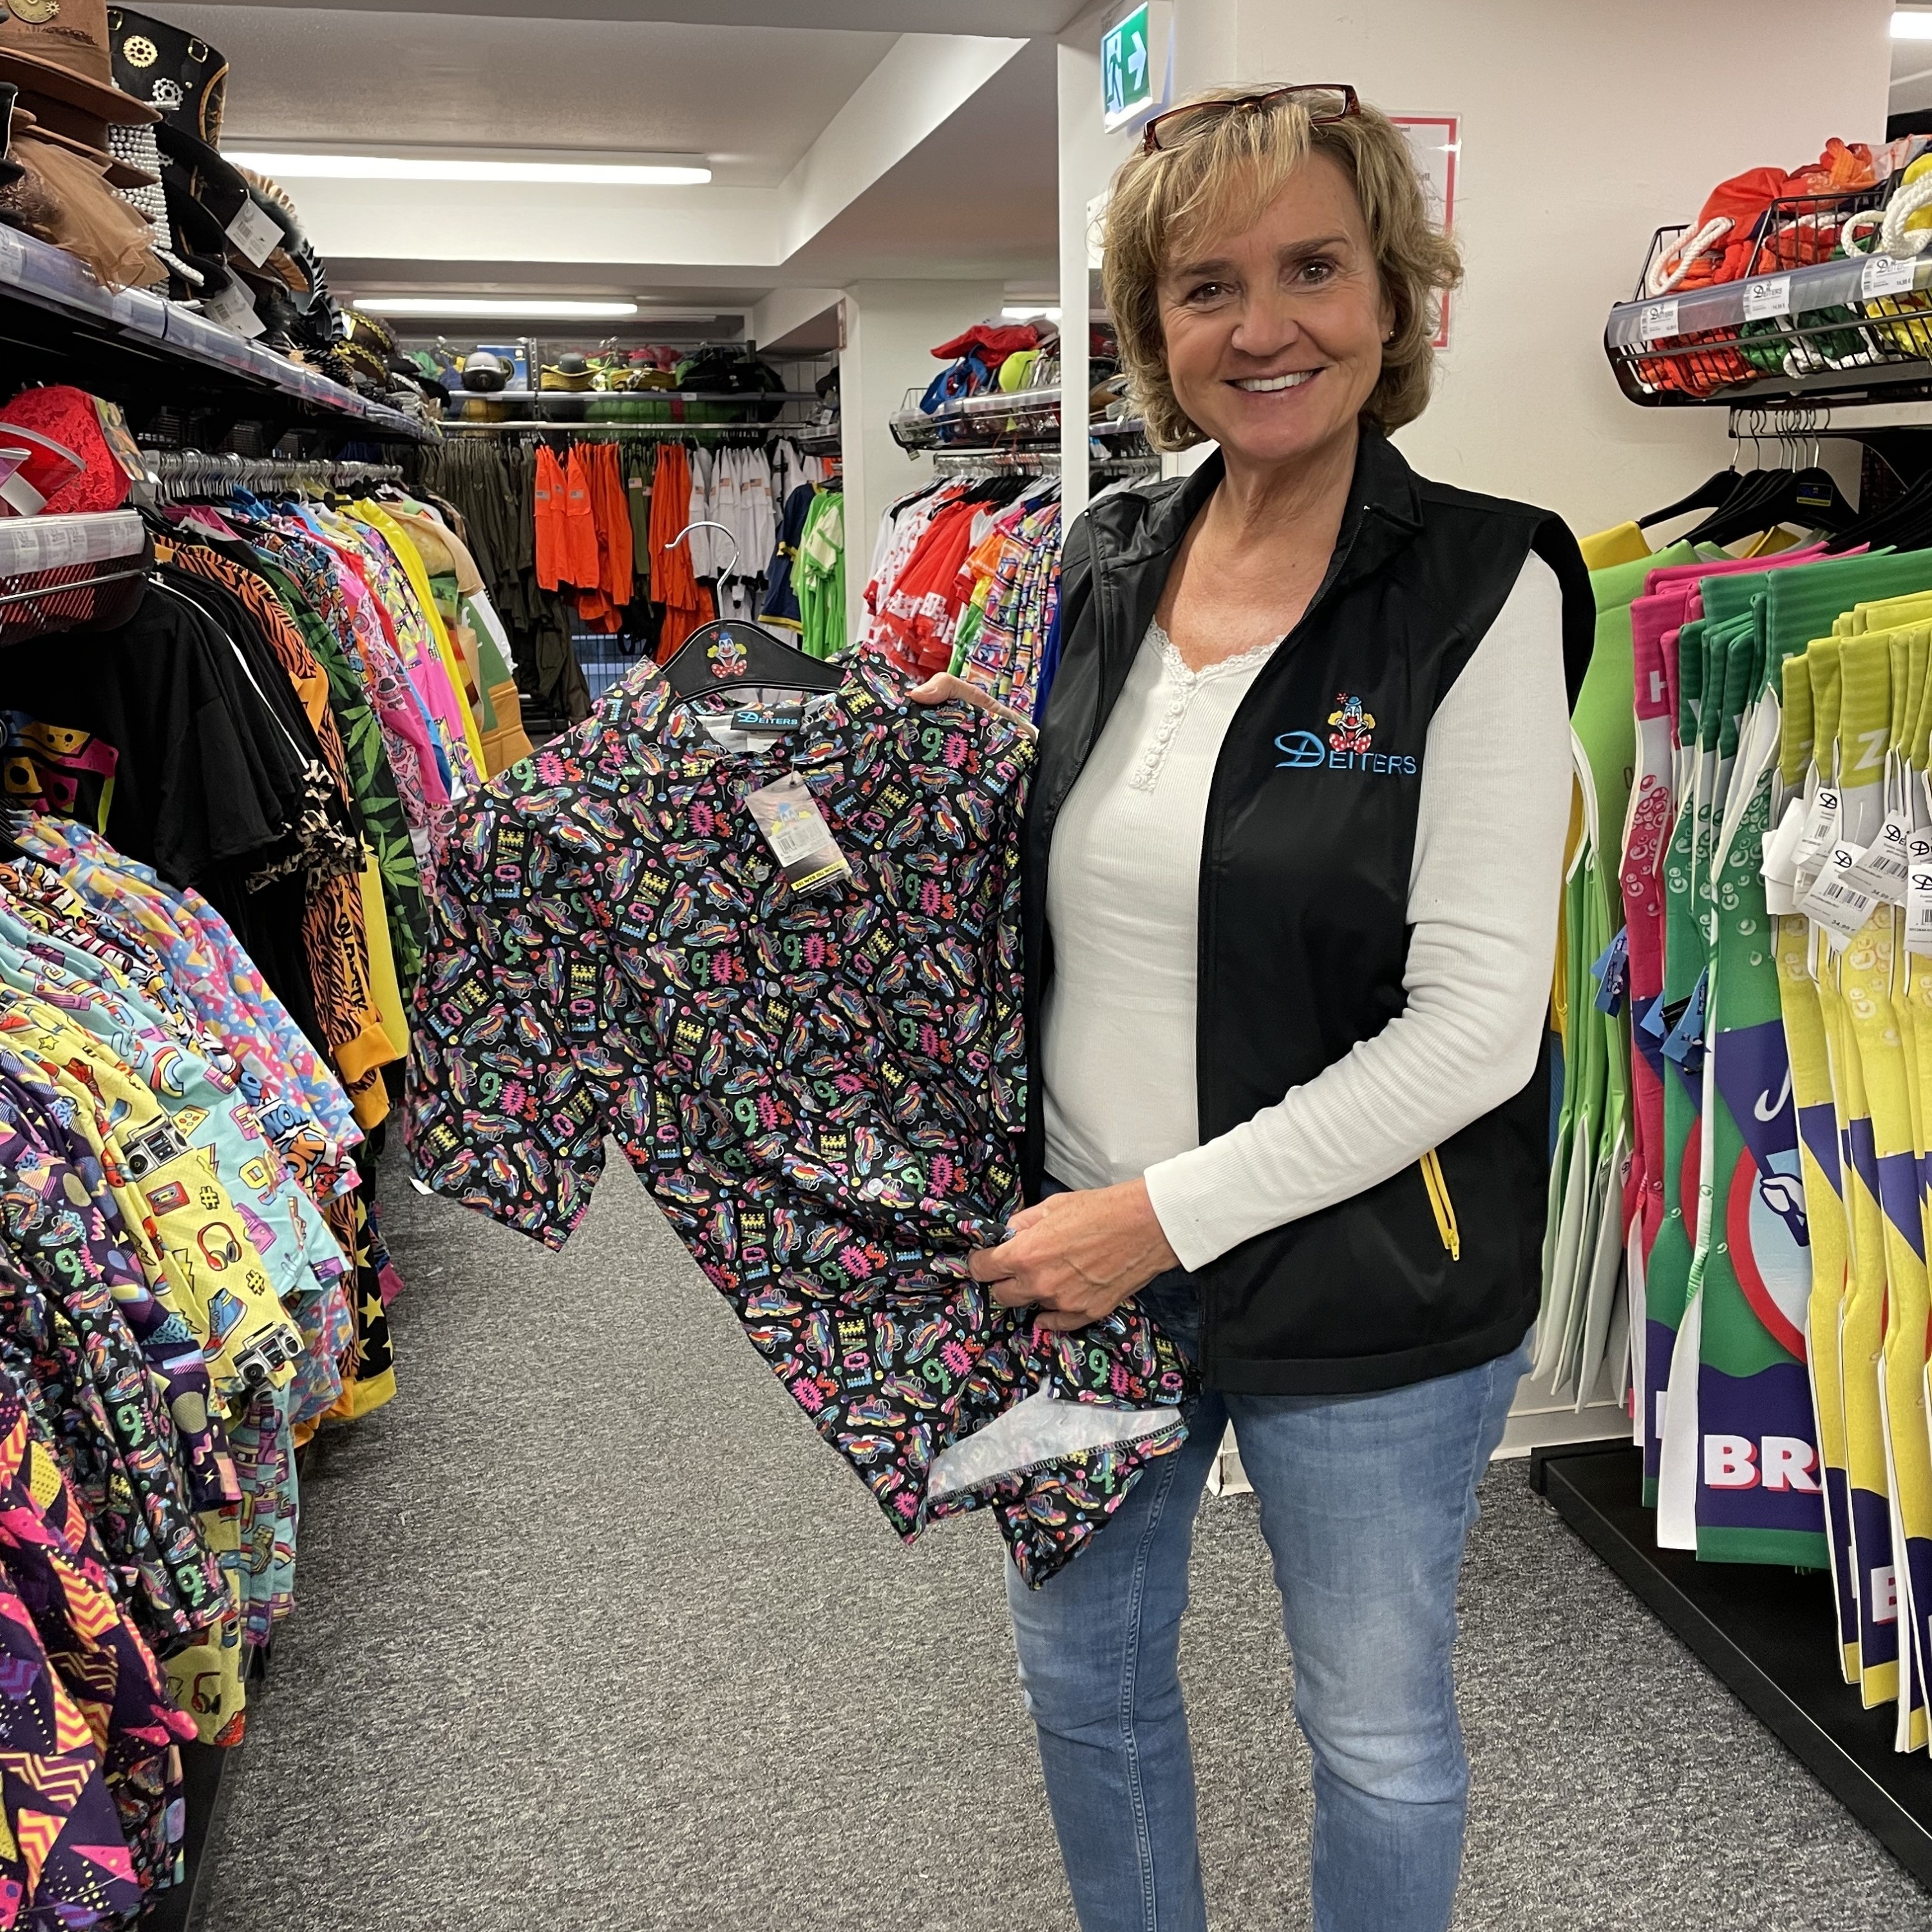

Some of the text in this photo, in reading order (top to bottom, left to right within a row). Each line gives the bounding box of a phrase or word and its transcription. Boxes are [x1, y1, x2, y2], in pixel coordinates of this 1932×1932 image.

[737, 712, 798, 725] DEITERS
[983, 738, 1037, 796] LOVE
[1274, 730, 1417, 774] DEITERS
[849, 784, 909, 846] LOVE
[495, 828, 525, 899] LOVE
[620, 871, 670, 940] LOVE
[845, 927, 895, 986] LOVE
[428, 978, 489, 1039] LOVE
[569, 964, 596, 1032] LOVE
[540, 1086, 594, 1150] LOVE
[656, 1091, 683, 1160] LOVE
[739, 1213, 772, 1280] LOVE
[838, 1318, 873, 1389] LOVE
[1155, 1337, 1184, 1405] LOVE
[1704, 1434, 1823, 1494] BR
